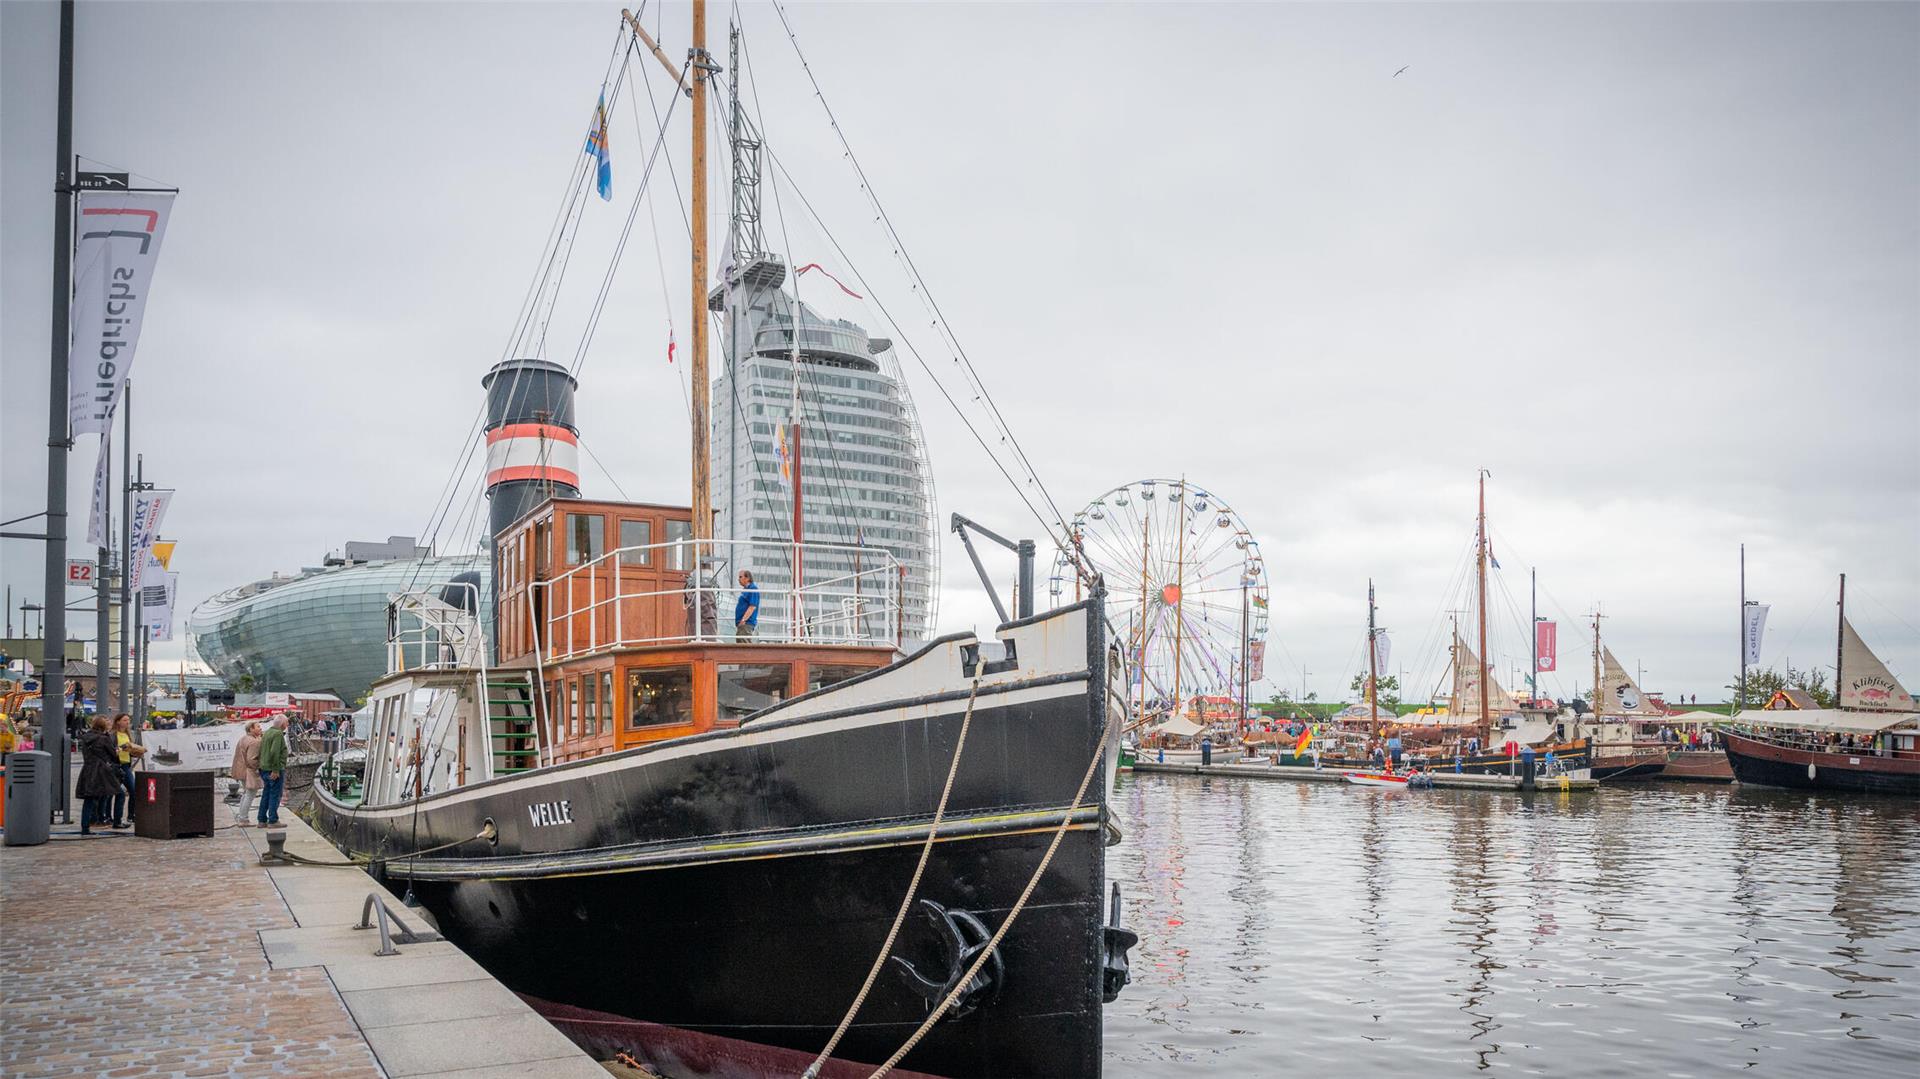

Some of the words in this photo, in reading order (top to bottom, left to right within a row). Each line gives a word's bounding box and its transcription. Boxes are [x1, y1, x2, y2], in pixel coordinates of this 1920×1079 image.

[70, 565, 91, 580] E2
[196, 740, 230, 752] WELLE
[528, 801, 573, 827] WELLE
